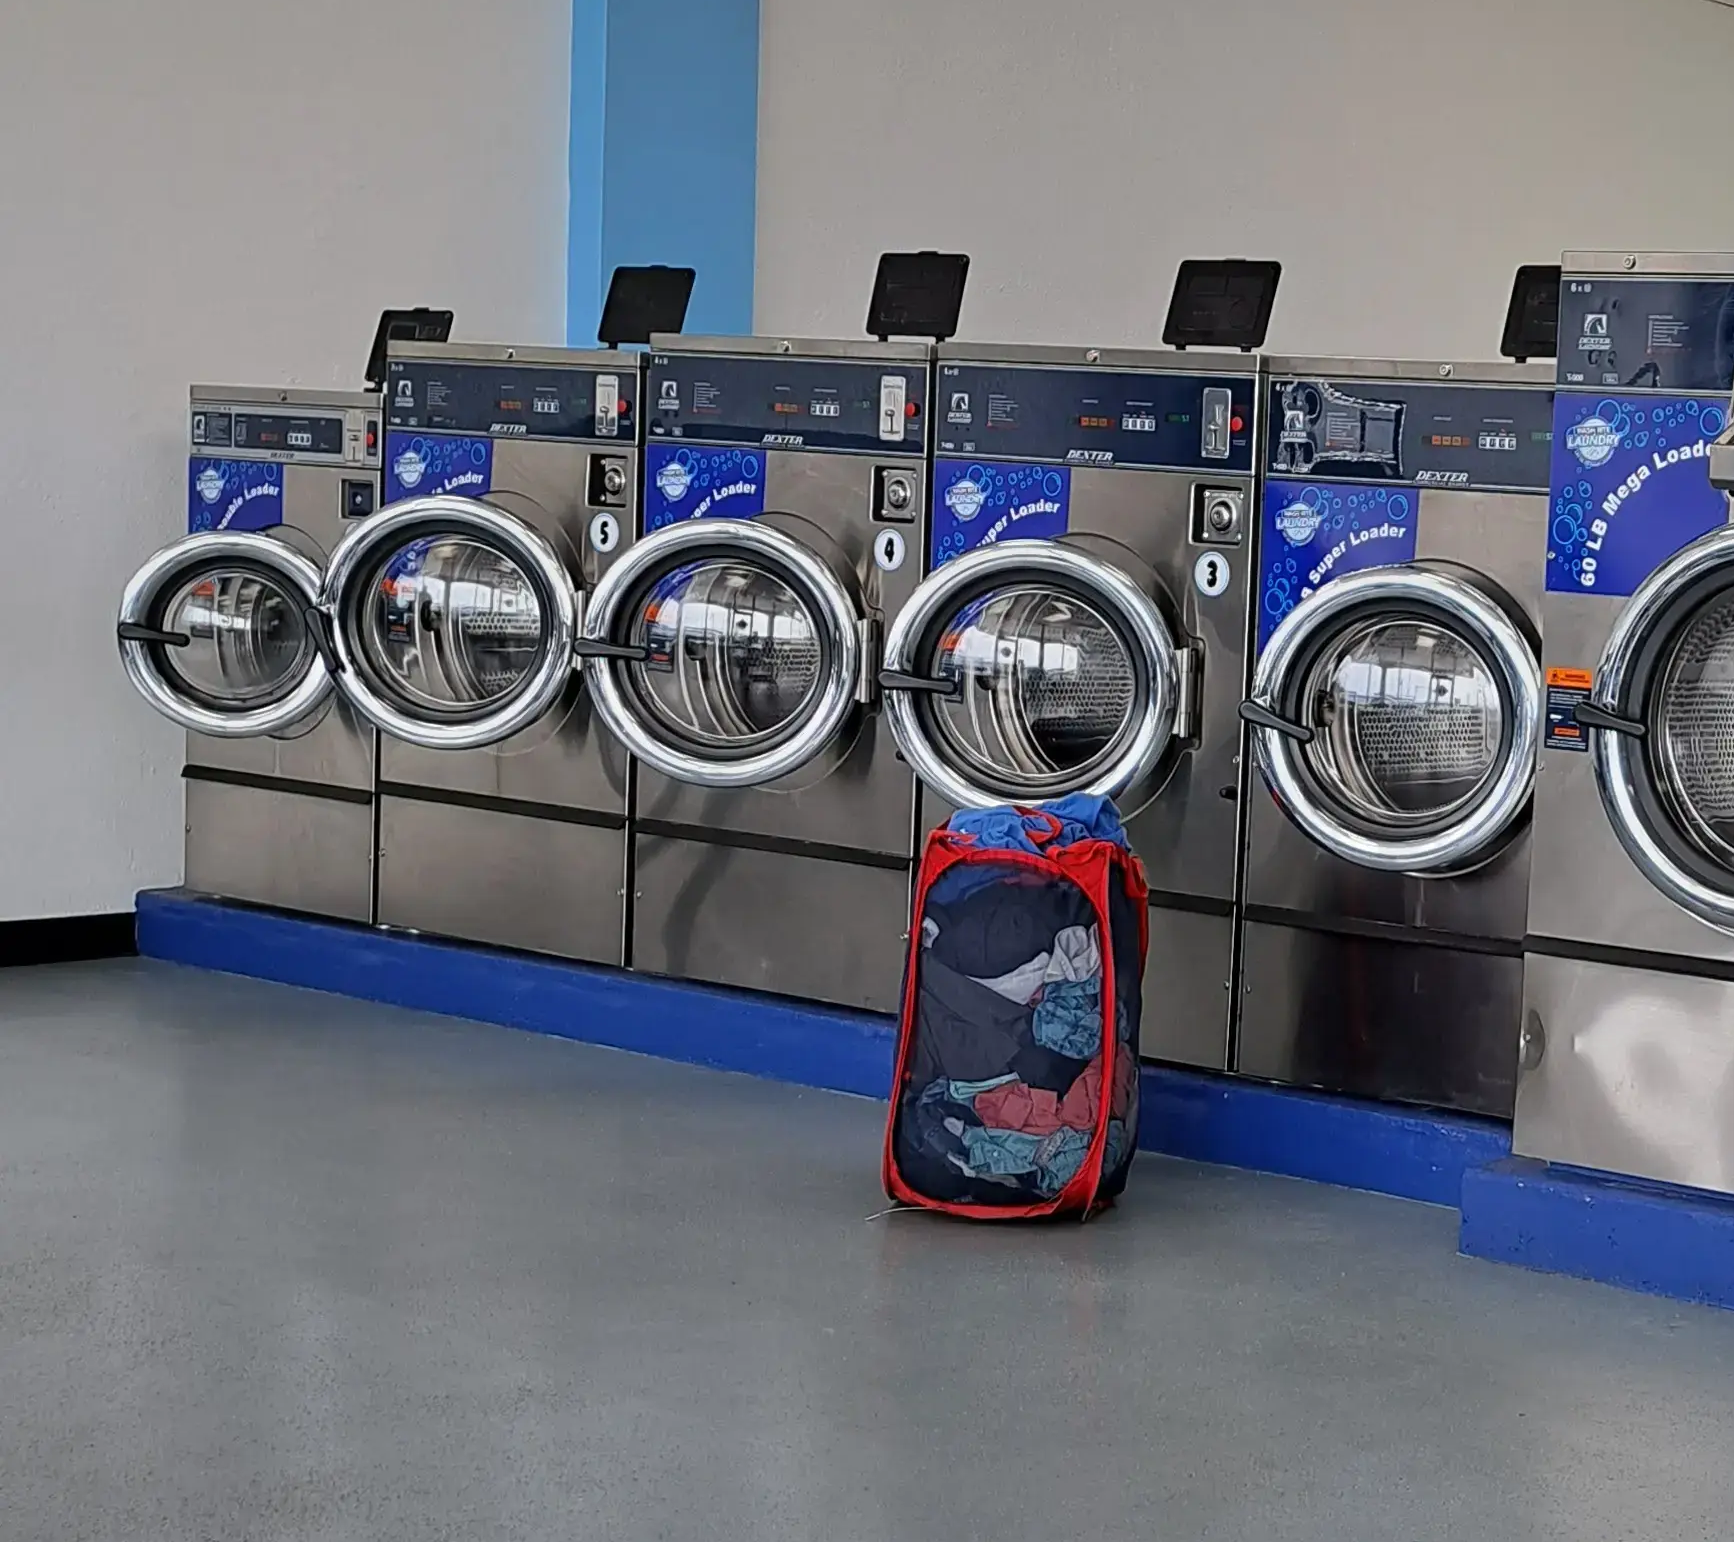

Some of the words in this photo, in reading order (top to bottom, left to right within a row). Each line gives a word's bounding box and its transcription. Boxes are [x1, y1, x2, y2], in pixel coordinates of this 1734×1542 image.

[763, 434, 804, 445] DEXTER
[1067, 449, 1114, 461] DEXTER
[1653, 440, 1710, 470] Load
[444, 470, 484, 490] Loader
[1416, 470, 1469, 482] DEXTER
[244, 482, 280, 500] Loader
[712, 481, 757, 501] Loader
[1602, 465, 1651, 516] Mega
[1010, 499, 1061, 521] Loader
[600, 521, 609, 545] 5
[1586, 518, 1607, 551] LB
[884, 537, 895, 563] 4
[1309, 540, 1346, 584] Super
[1350, 523, 1407, 547] Loader
[1207, 560, 1218, 588] 3
[1581, 557, 1597, 587] 60
